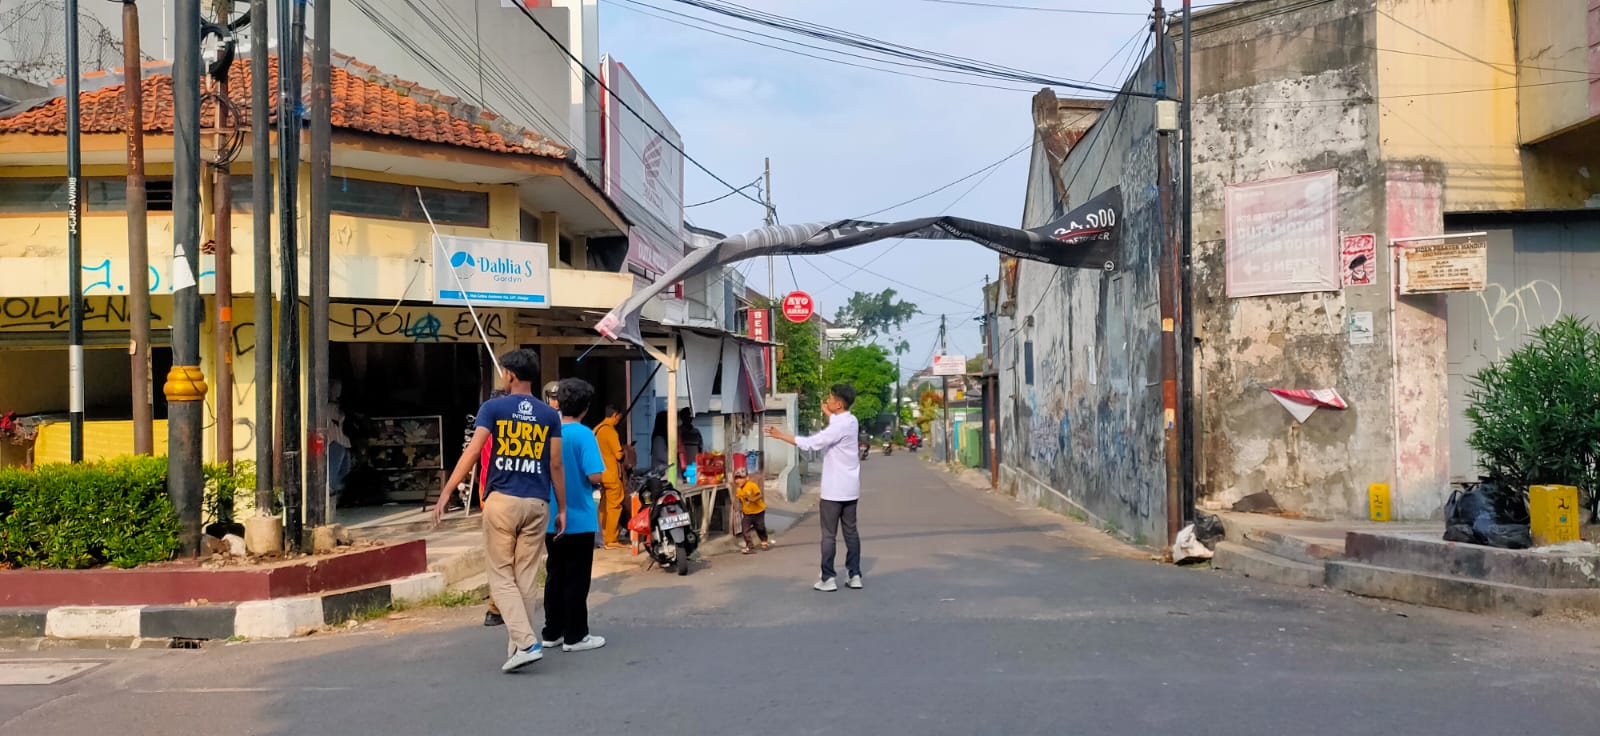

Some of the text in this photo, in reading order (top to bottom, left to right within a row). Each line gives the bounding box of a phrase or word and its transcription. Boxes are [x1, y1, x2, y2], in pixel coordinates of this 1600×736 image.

[480, 256, 532, 277] Dahlia S
[787, 297, 809, 305] AYO
[496, 420, 549, 442] TURN
